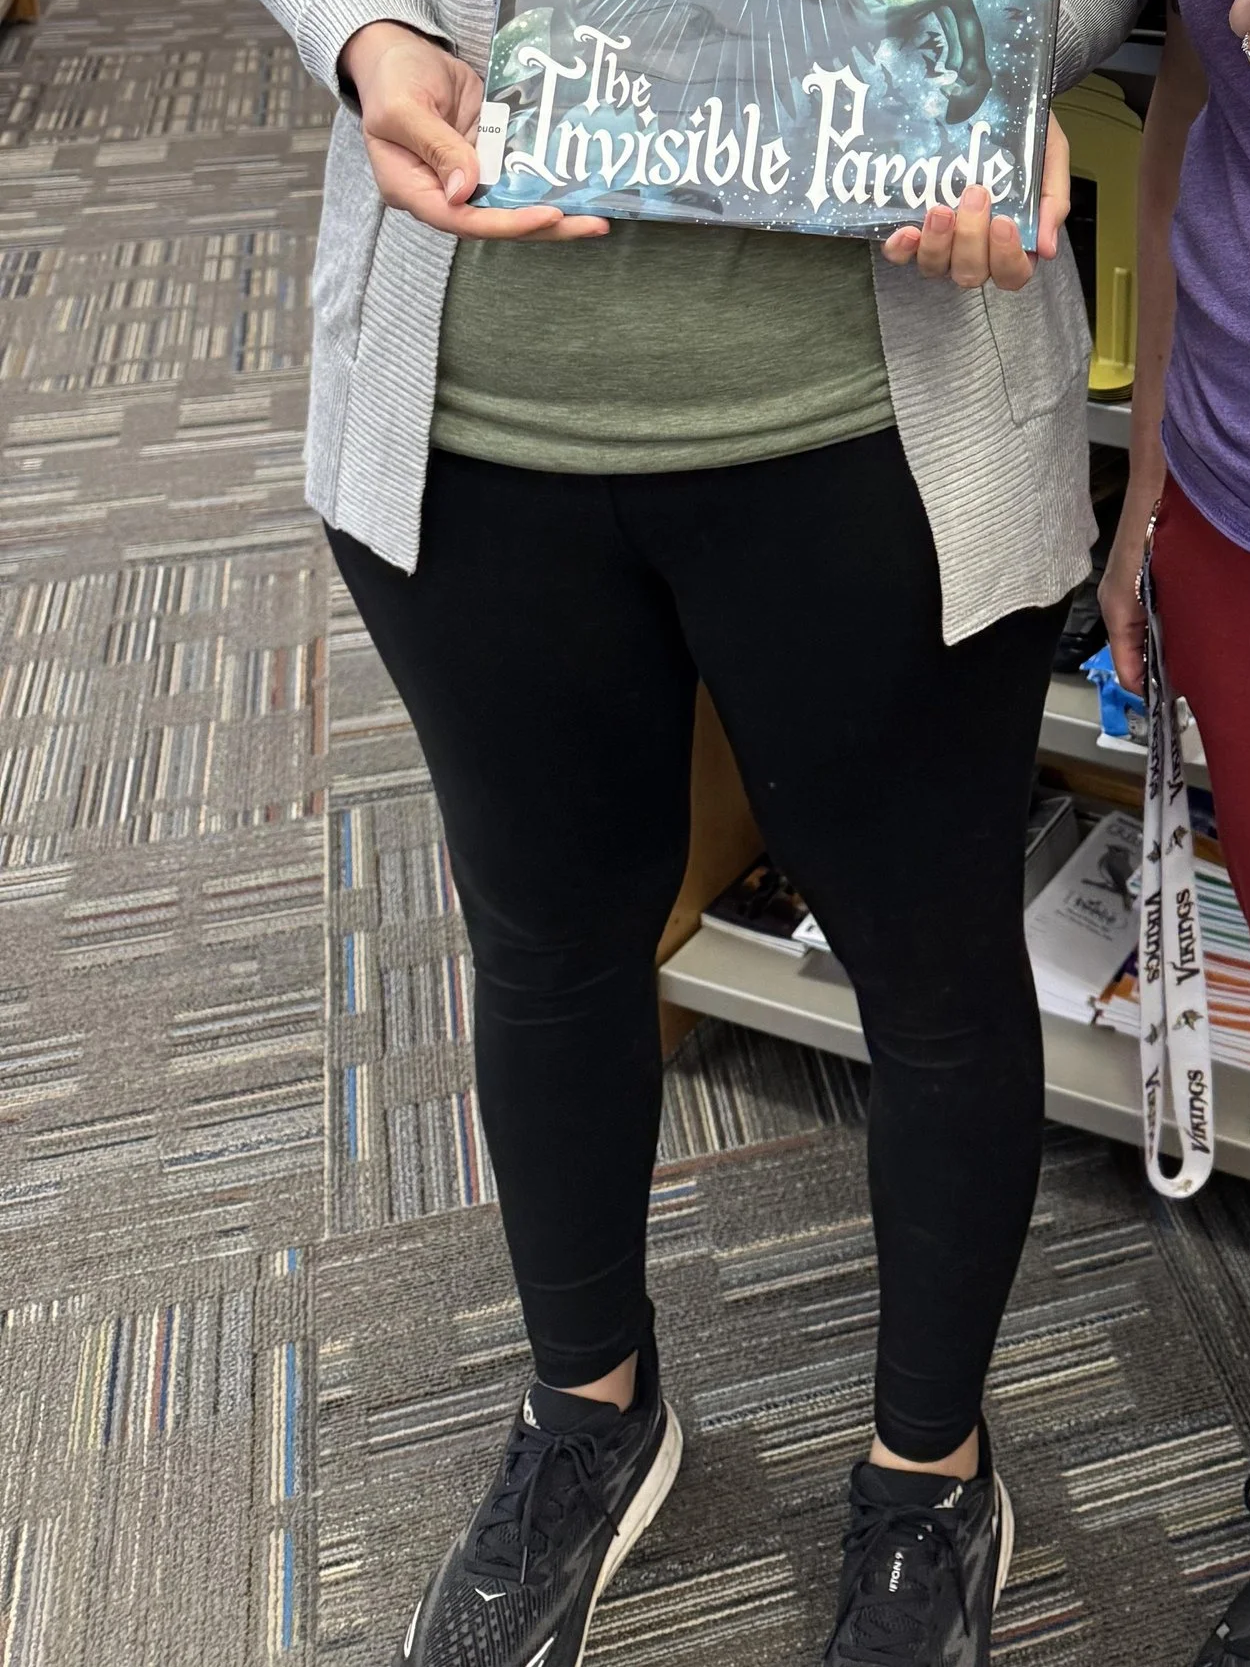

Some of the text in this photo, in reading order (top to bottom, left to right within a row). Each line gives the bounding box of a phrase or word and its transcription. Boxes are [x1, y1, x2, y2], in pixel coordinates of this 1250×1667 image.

[574, 25, 651, 115] The
[505, 46, 1015, 213] Invisible Parade
[1144, 887, 1162, 984] VIKINGS
[1168, 888, 1200, 986] VIKINGS
[1184, 1070, 1211, 1154] VIKINGS
